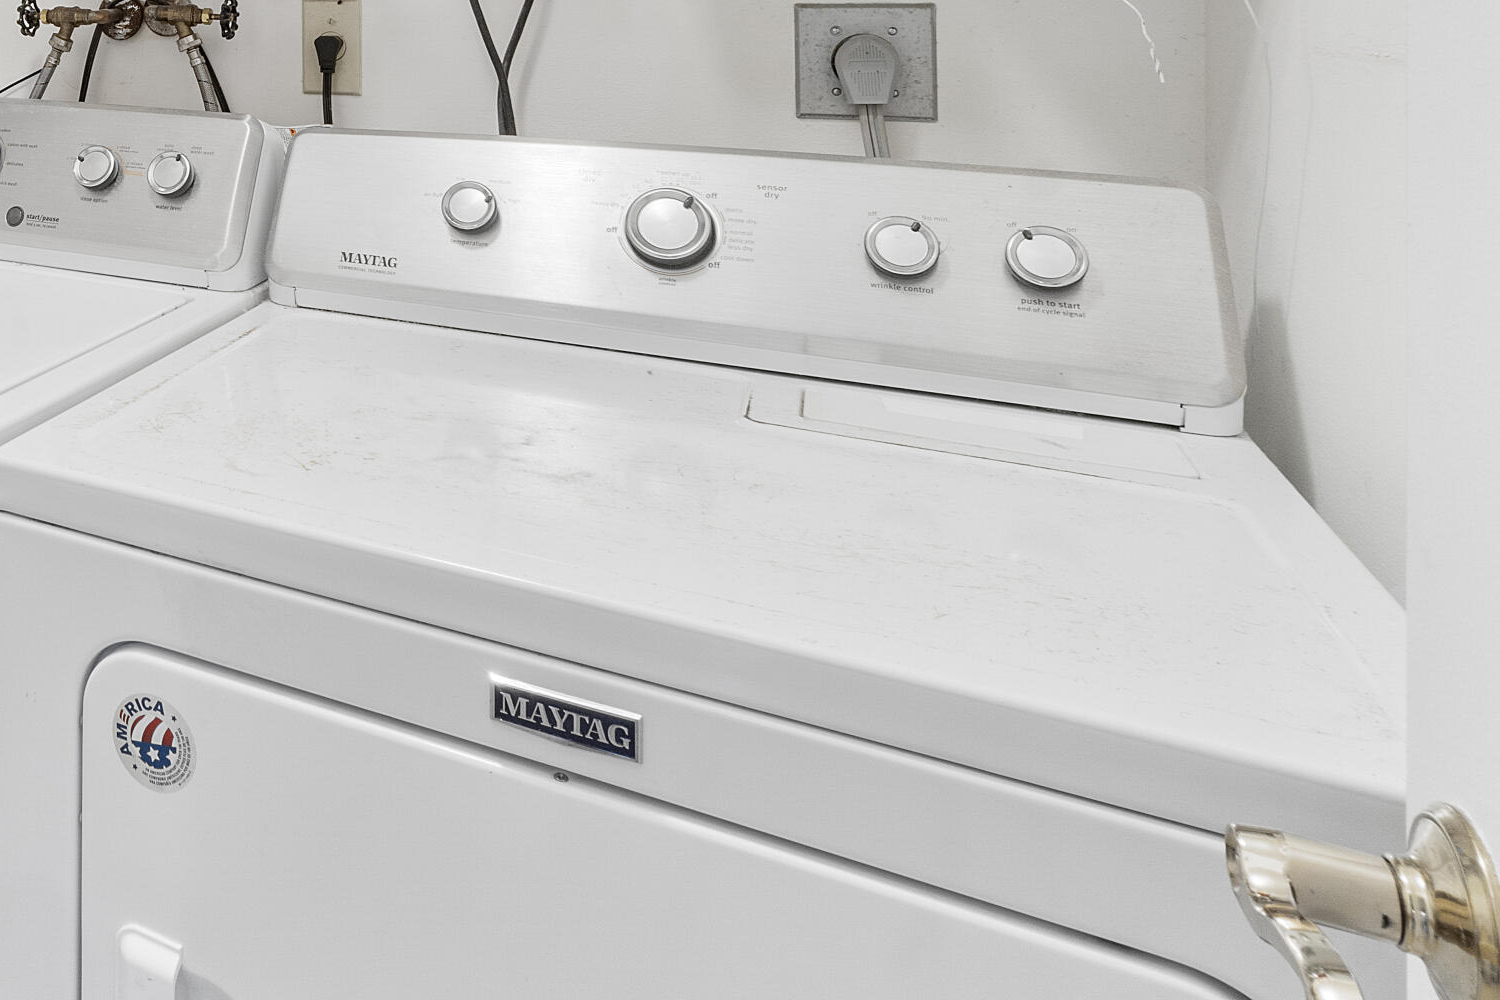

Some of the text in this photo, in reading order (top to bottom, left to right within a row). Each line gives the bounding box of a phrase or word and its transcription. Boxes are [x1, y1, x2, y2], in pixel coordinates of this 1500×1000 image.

[756, 184, 788, 192] sensor
[764, 191, 780, 200] dry
[26, 213, 60, 223] start/pause
[605, 226, 618, 234] off
[339, 251, 398, 269] MAYTAG
[707, 261, 721, 269] off
[870, 282, 934, 294] wrinkle control
[1020, 298, 1081, 310] push to start
[499, 691, 632, 750] MAYTAG
[116, 696, 165, 757] AMERICA
